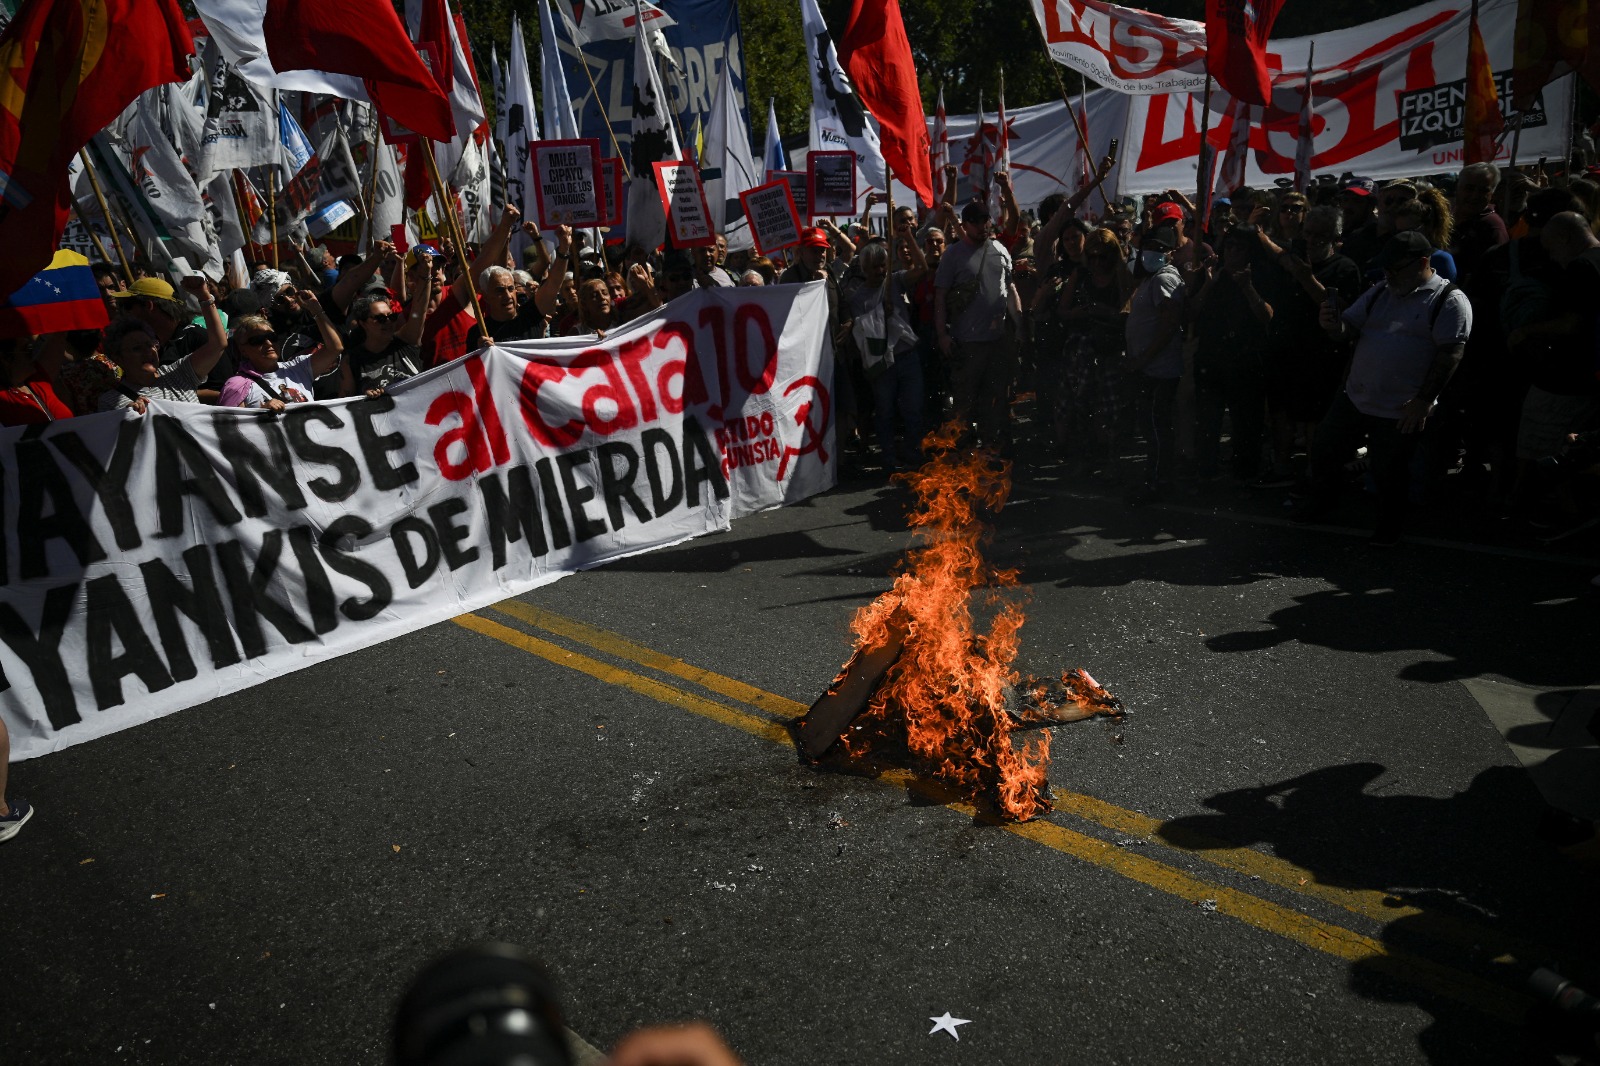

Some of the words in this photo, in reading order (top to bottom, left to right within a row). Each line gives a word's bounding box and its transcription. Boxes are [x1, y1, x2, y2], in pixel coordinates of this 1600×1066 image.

[608, 33, 746, 122] LBRES
[1090, 63, 1122, 88] Socialista
[1123, 83, 1136, 91] de
[1138, 82, 1154, 91] los
[548, 152, 578, 167] MILEI
[548, 167, 584, 183] CIPAYO
[543, 183, 566, 195] MULO
[567, 182, 578, 193] DE
[579, 181, 592, 192] LOS
[552, 193, 586, 206] YANQUIS
[0, 393, 419, 586] ÁYANSE
[425, 356, 511, 481] al
[520, 303, 778, 448] carajo
[0, 514, 394, 732] YANKIS
[390, 498, 480, 590] DE
[479, 414, 730, 572] MIERDA
